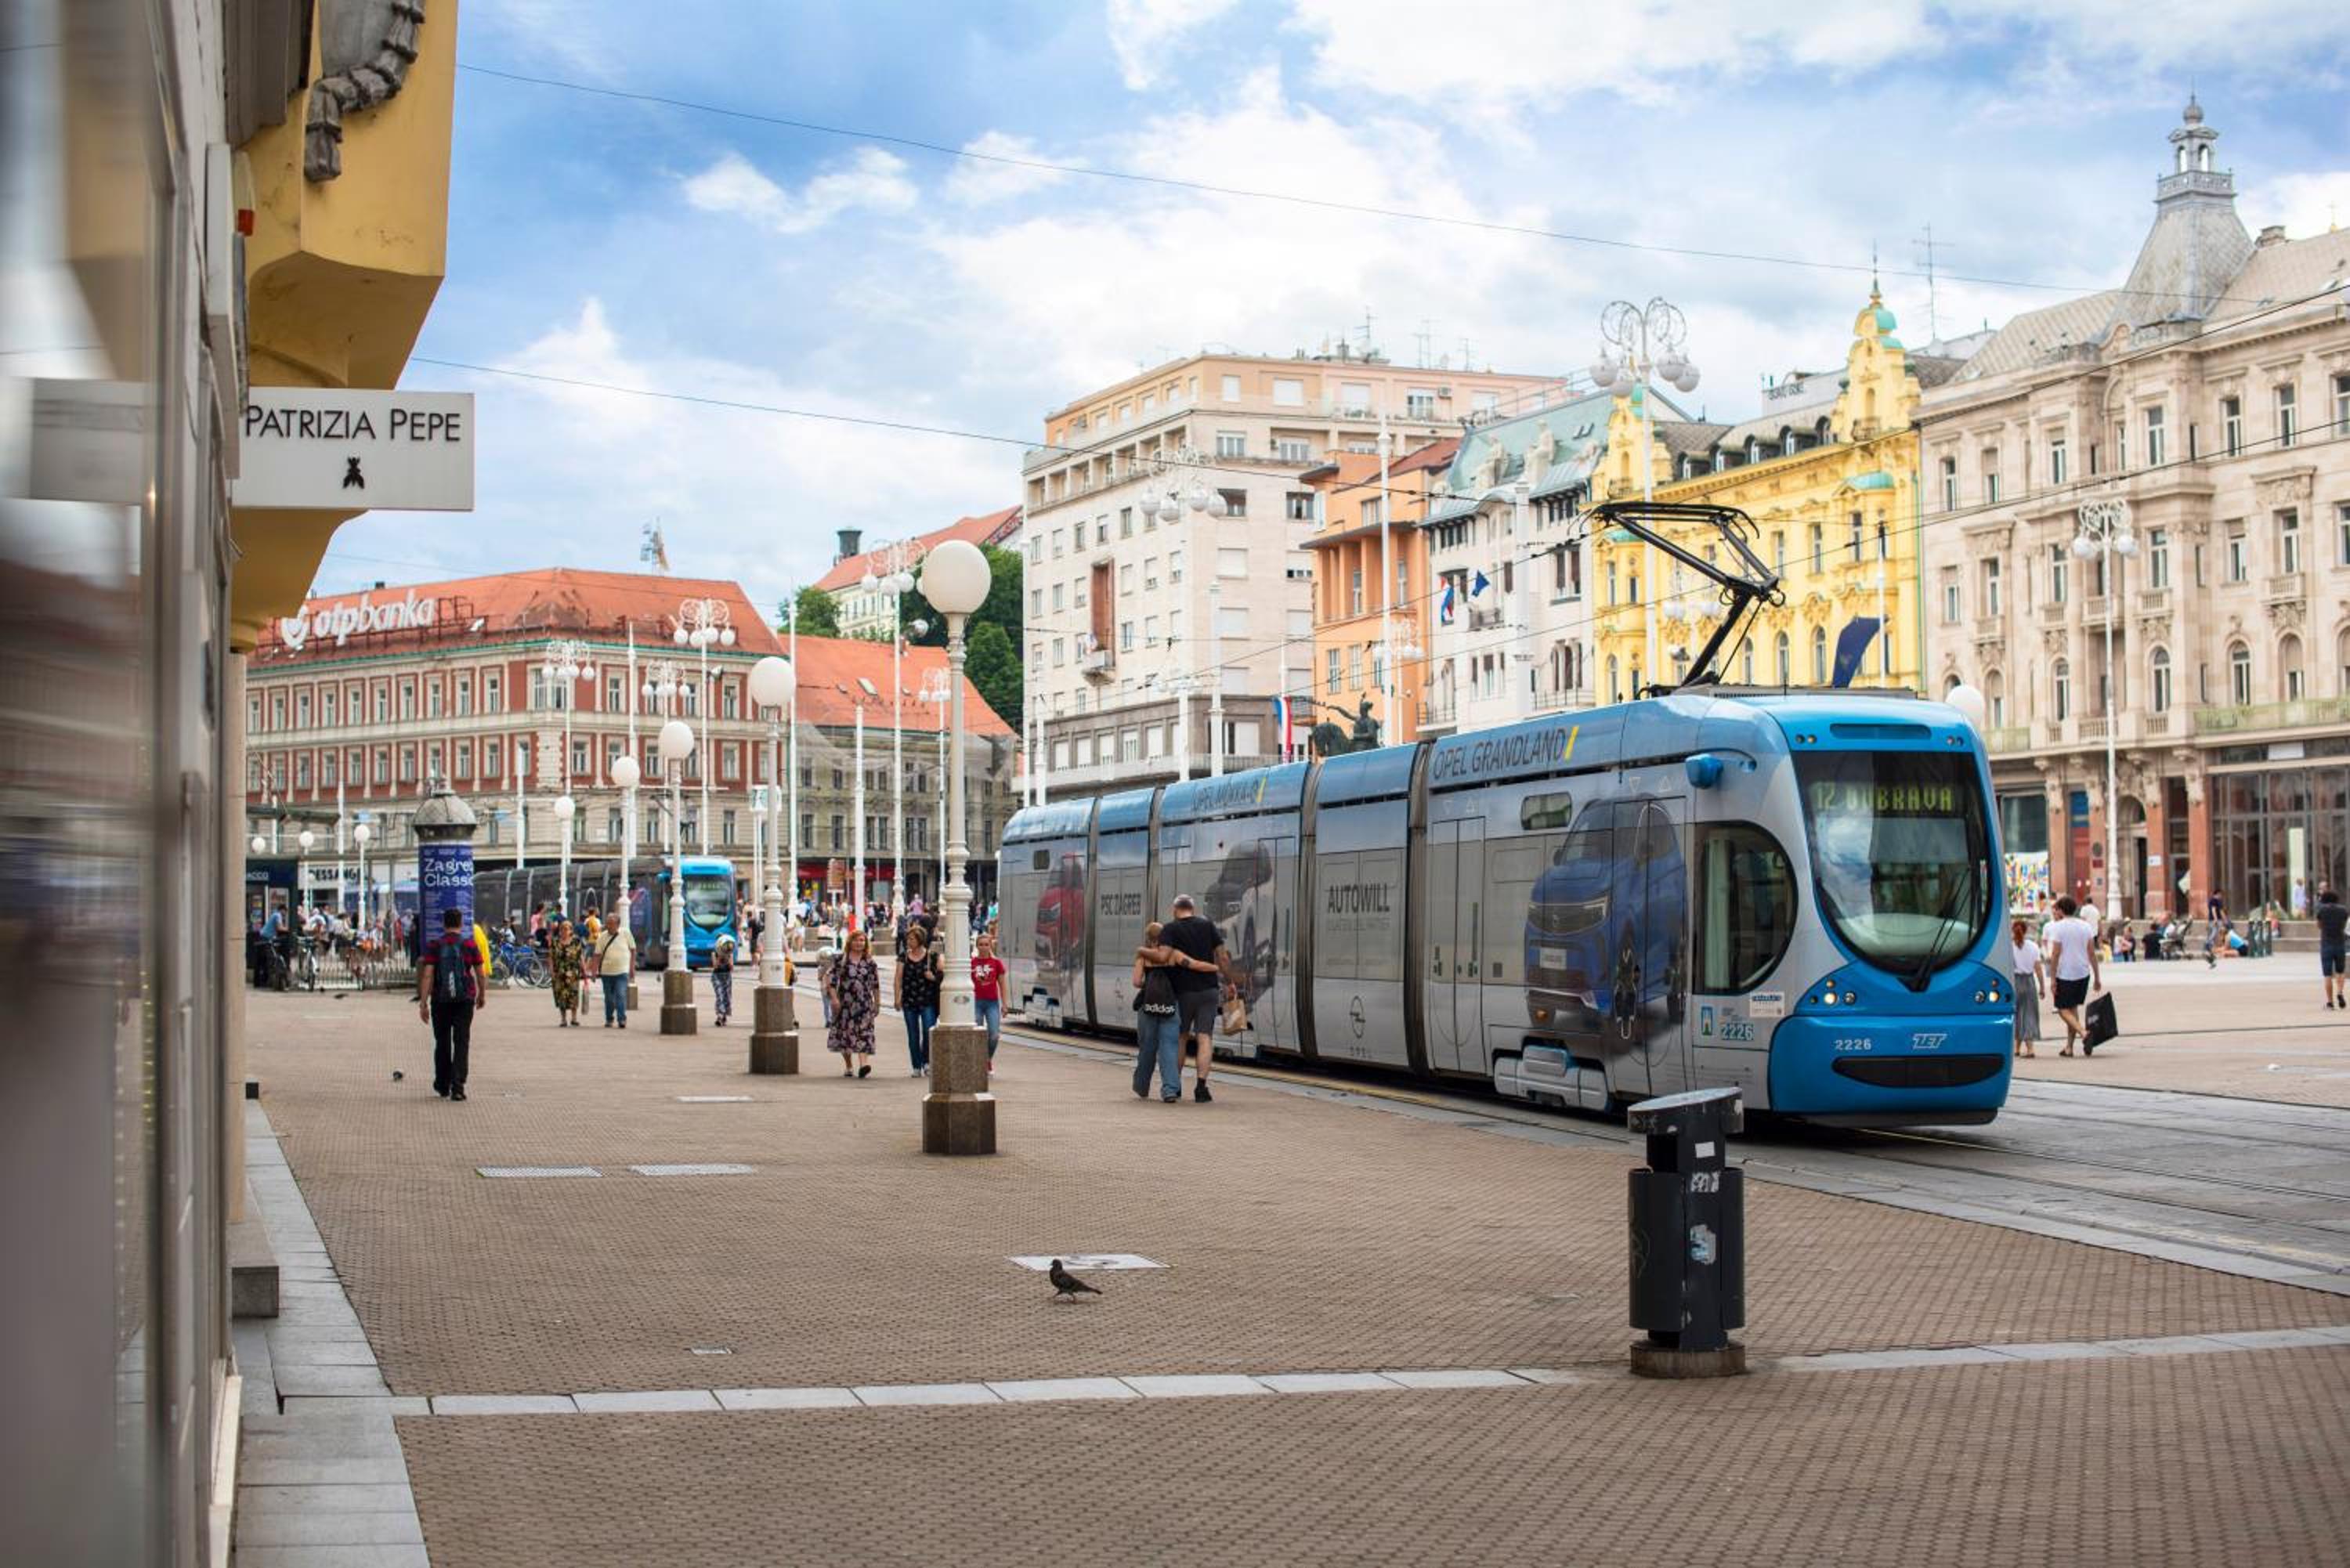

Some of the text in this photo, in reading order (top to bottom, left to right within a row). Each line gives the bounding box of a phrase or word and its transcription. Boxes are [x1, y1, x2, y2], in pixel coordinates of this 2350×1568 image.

[246, 405, 461, 441] PATRIZIA PEPE
[313, 589, 443, 646] otpbanka
[1434, 728, 1566, 779] OPEL GRANDLAND
[1817, 782, 1837, 810] 12
[1114, 893, 1141, 916] ZAGREB
[1328, 883, 1390, 914] AUTOWILL
[1723, 1022, 1755, 1041] 2226
[1835, 1038, 1872, 1050] 2226
